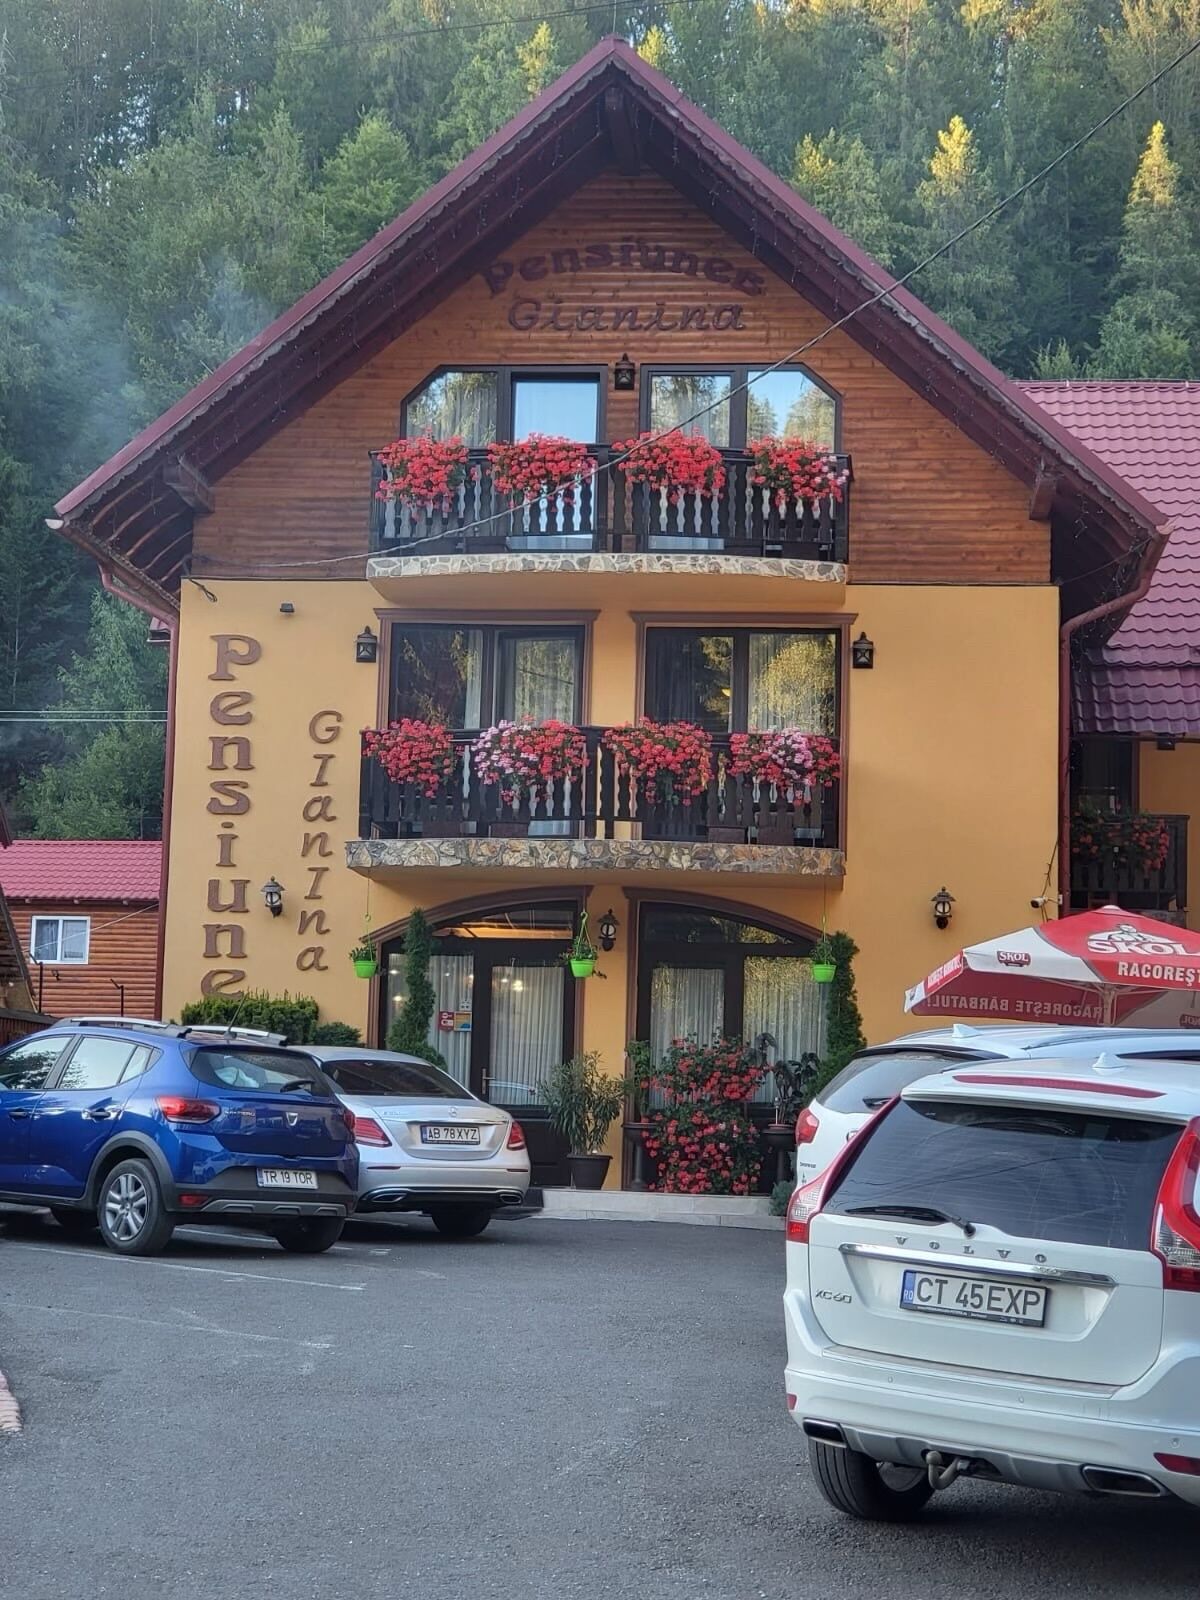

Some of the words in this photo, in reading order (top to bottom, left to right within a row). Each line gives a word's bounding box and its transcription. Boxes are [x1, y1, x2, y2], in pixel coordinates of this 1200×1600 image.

[508, 299, 746, 331] Gianina
[1087, 941, 1200, 956] SKOL
[999, 951, 1029, 962] SKOL
[263, 1170, 278, 1184] TR
[280, 1171, 291, 1184] 19
[293, 1171, 313, 1185] TOR
[895, 1236, 1047, 1264] VOLVO
[815, 1290, 853, 1304] XC60
[903, 1289, 914, 1301] RO
[917, 1277, 949, 1305] CT
